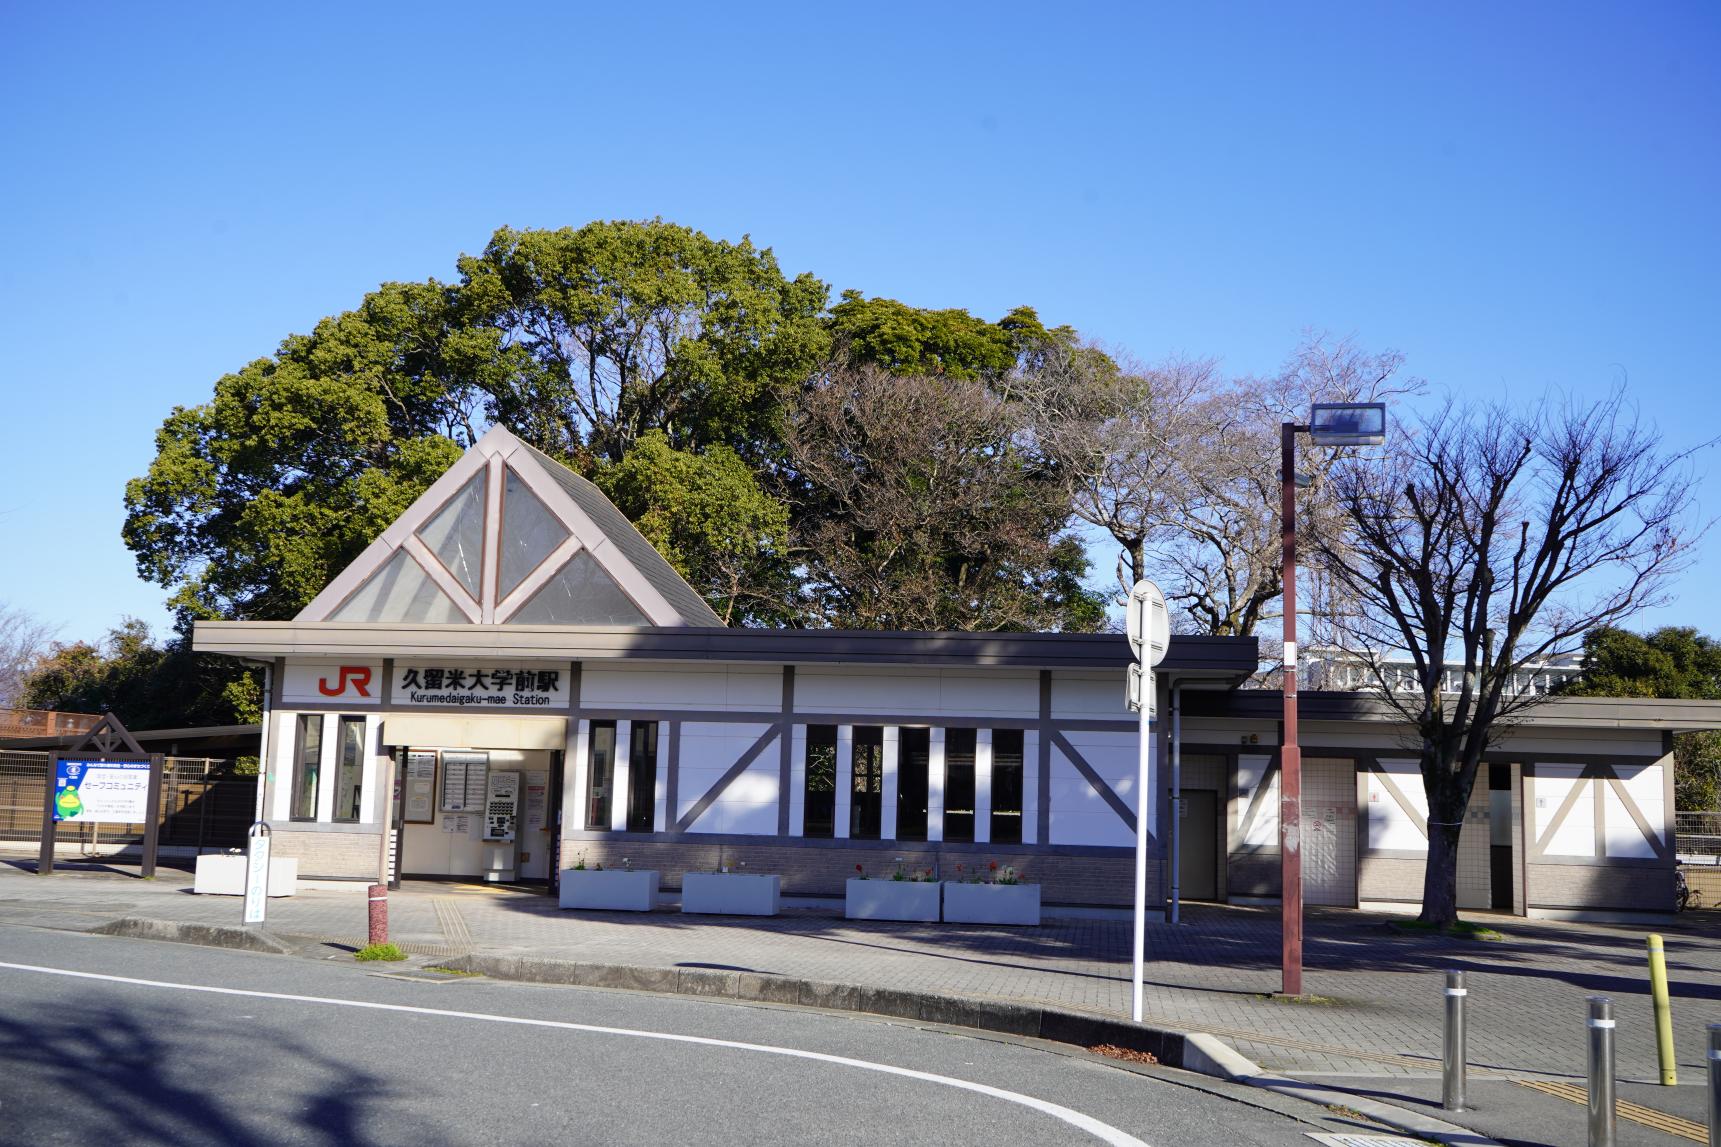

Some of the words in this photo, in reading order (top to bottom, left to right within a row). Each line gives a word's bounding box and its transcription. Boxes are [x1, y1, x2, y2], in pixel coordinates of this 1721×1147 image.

[318, 666, 372, 697] JR
[401, 668, 560, 692] 久留米大学前駅
[410, 691, 507, 706] Kurumedaigaku-mae
[512, 692, 550, 705] Station
[84, 781, 148, 791] セーフコミュニティ
[249, 839, 266, 919] タクシーのりば
